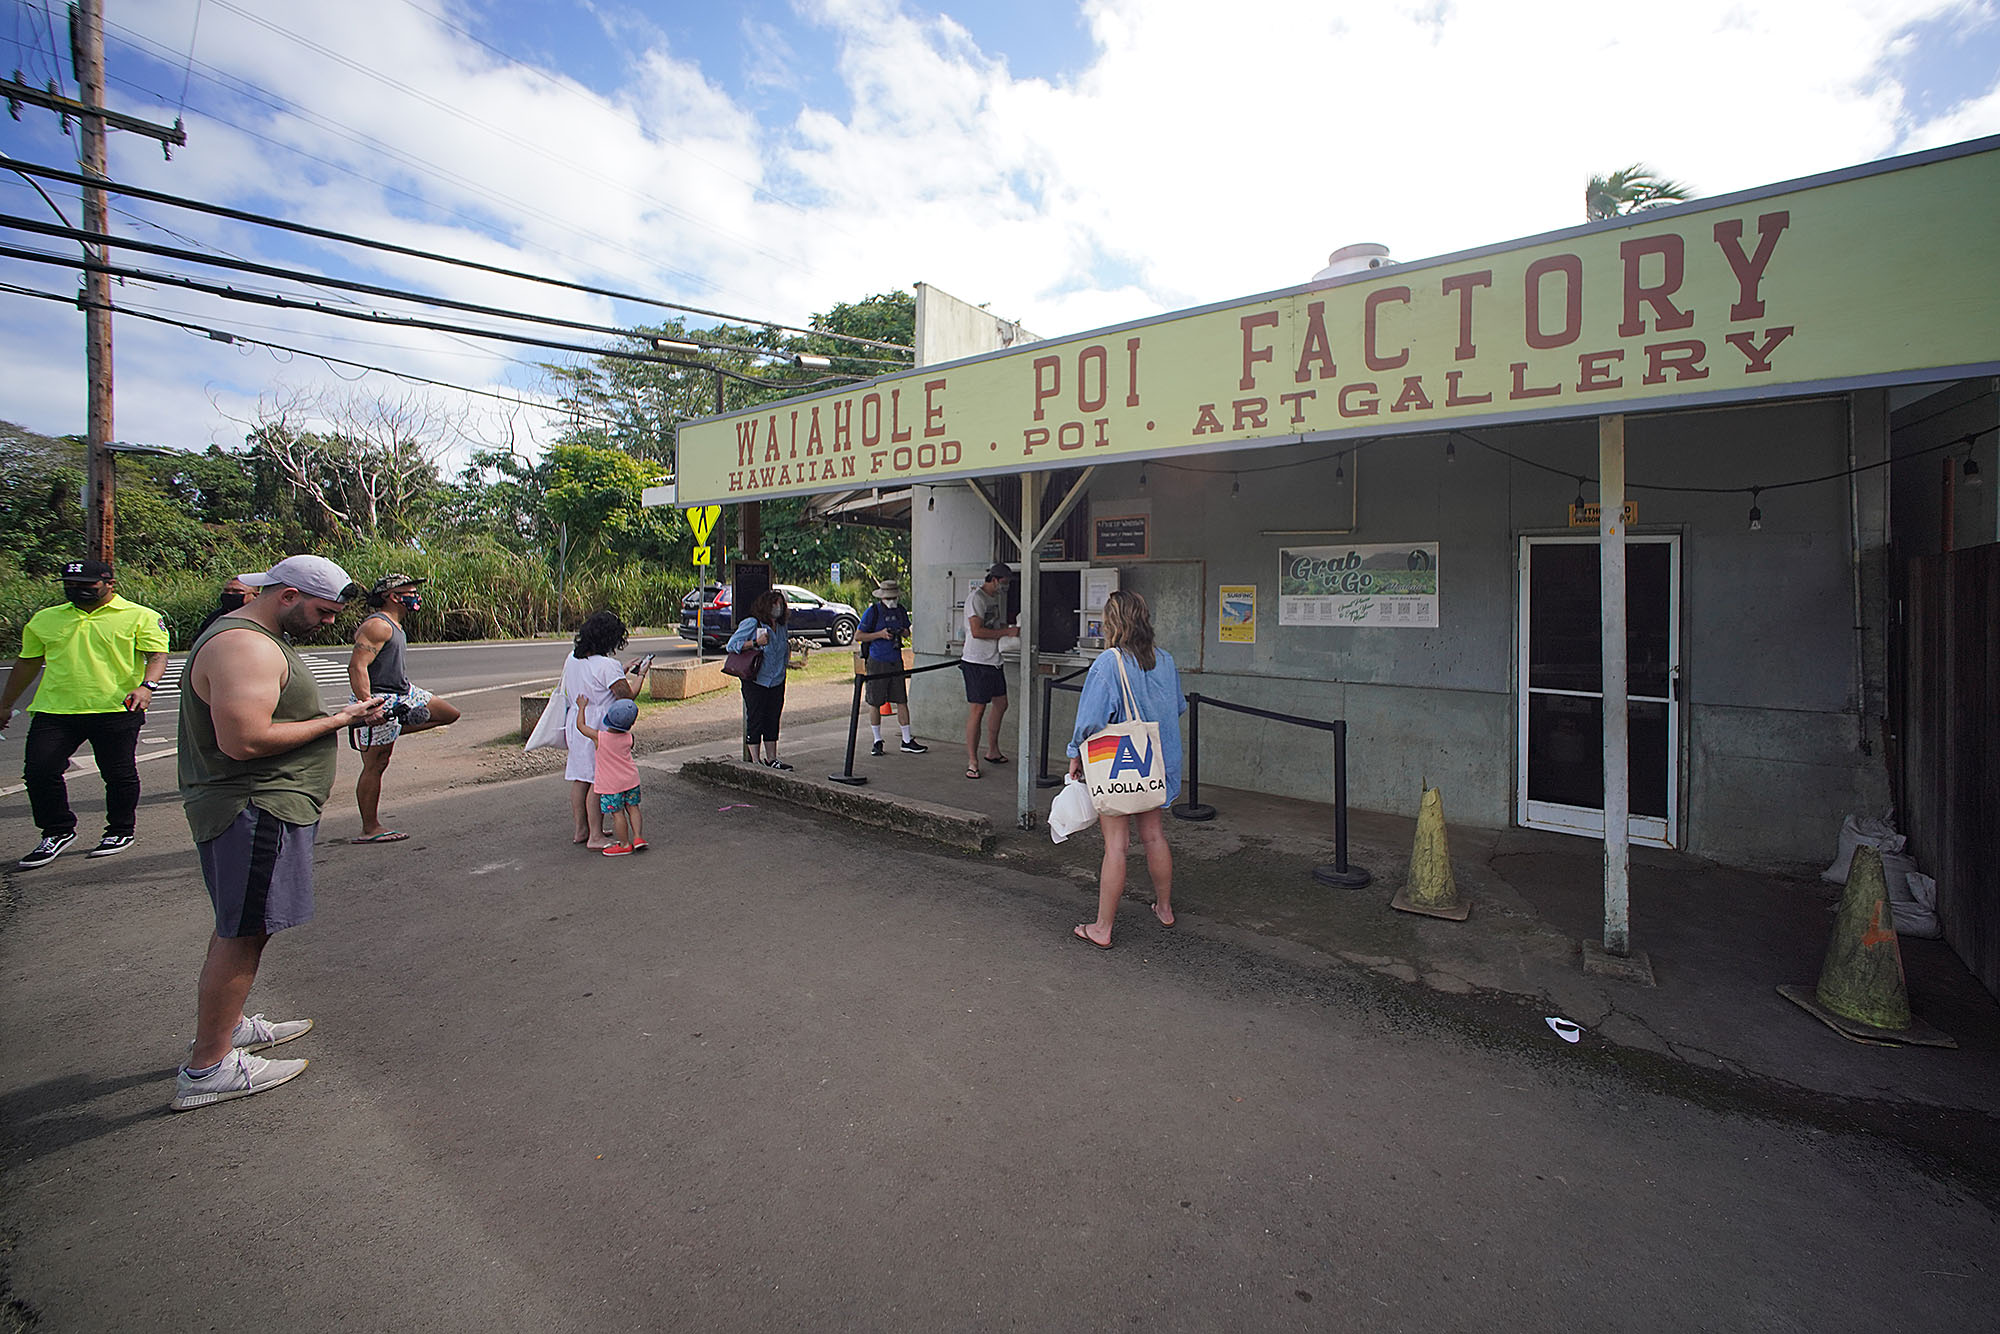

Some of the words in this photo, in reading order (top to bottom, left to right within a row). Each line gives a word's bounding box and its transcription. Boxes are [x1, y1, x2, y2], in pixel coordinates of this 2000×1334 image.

[735, 378, 947, 467] WAIAHOLE
[1033, 337, 1141, 421] POI
[1239, 211, 1791, 391] FACTORY
[728, 455, 856, 492] HAWAIIAN
[870, 440, 962, 474] FOOD
[1023, 418, 1110, 456] POI
[67, 563, 84, 573] H
[1290, 550, 1362, 582] Grab
[1340, 571, 1374, 594] Go
[1226, 591, 1253, 599] SURFING
[1091, 785, 1105, 797] LA
[1107, 782, 1148, 794] JOLLA,
[1149, 779, 1165, 790] CA
